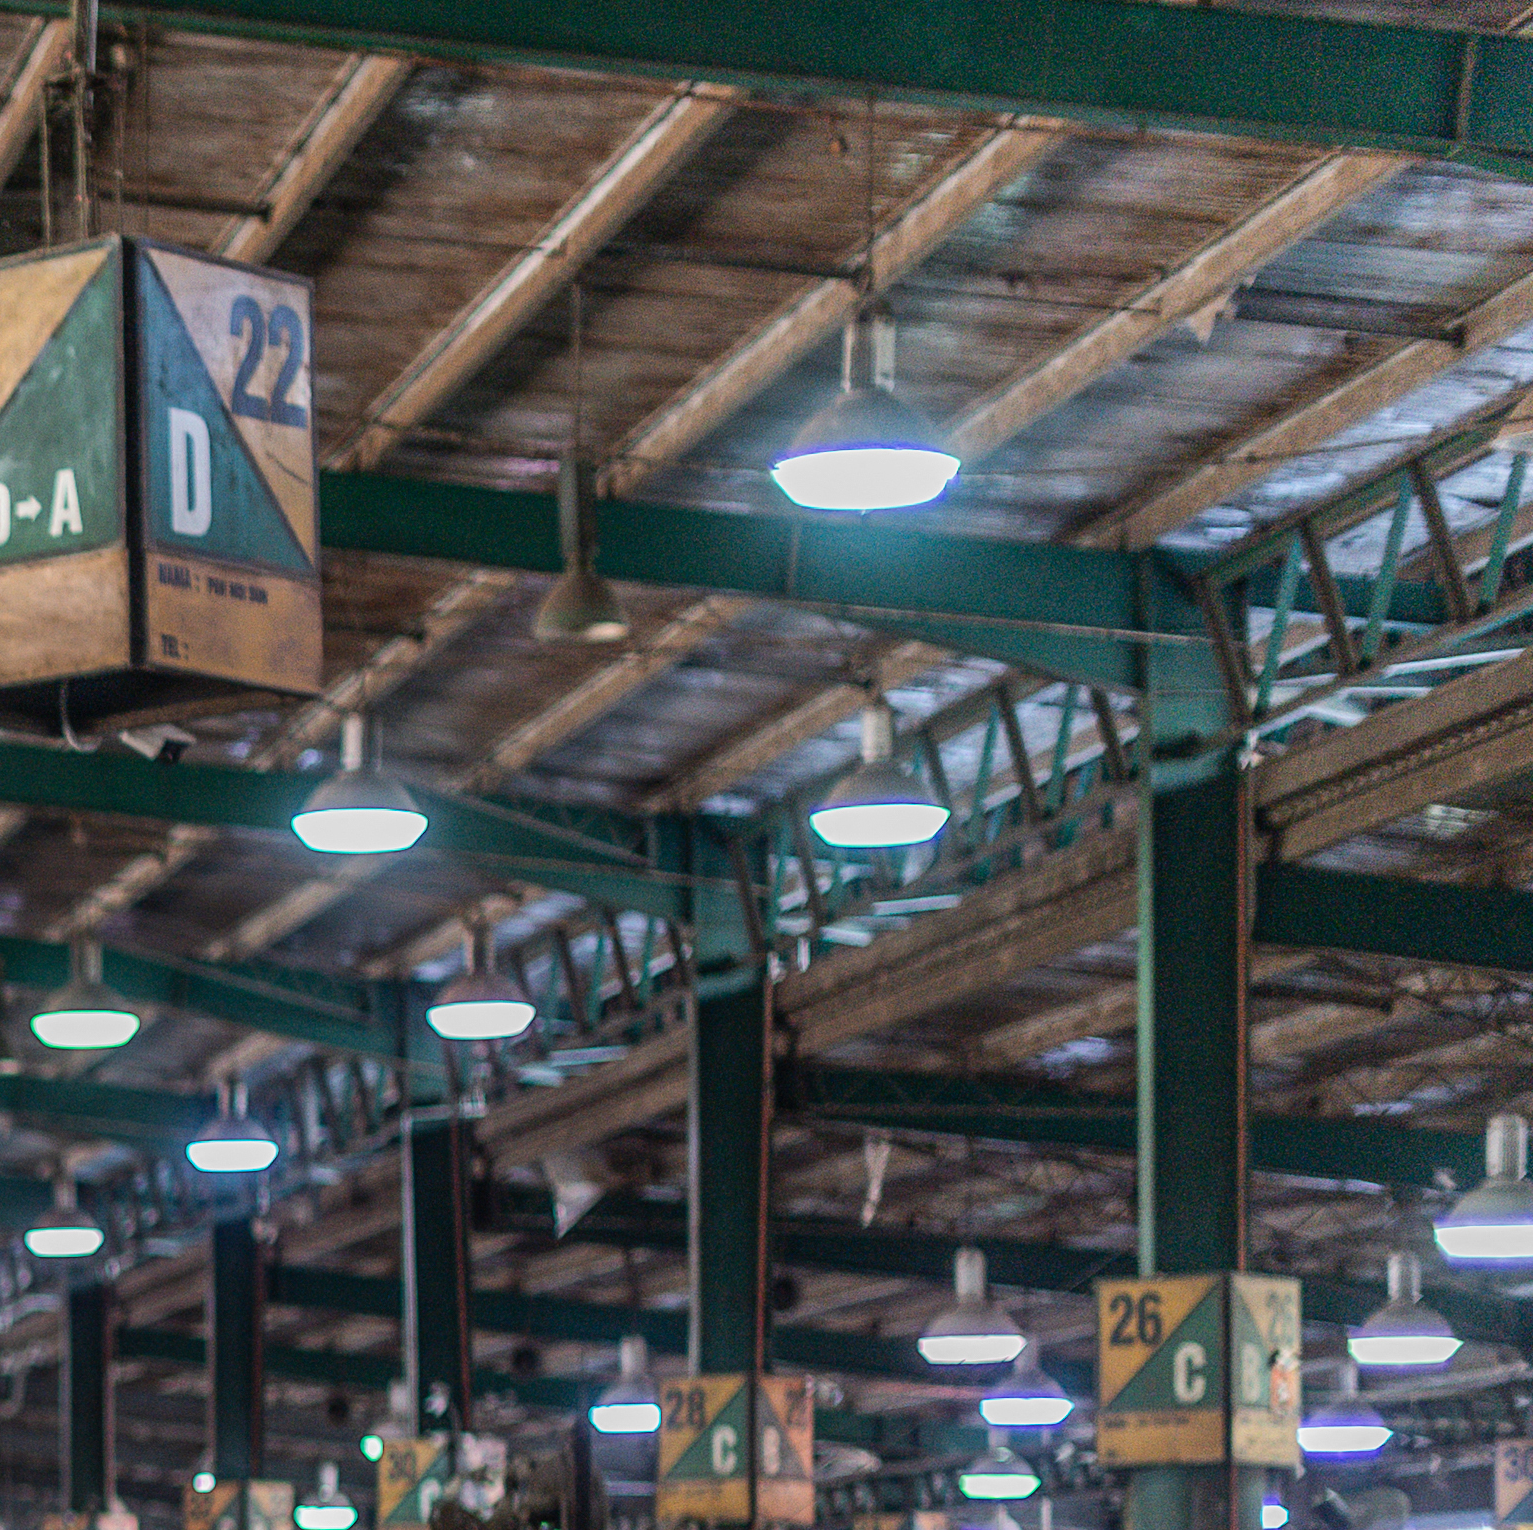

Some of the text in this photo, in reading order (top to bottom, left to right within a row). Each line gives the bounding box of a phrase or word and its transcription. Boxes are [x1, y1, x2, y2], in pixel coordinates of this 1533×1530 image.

[231, 296, 309, 429] 22
[48, 469, 83, 537] A
[168, 407, 212, 537] D
[1110, 1291, 1162, 1345] 26
[1173, 1341, 1207, 1404] C
[711, 1424, 738, 1476] C
